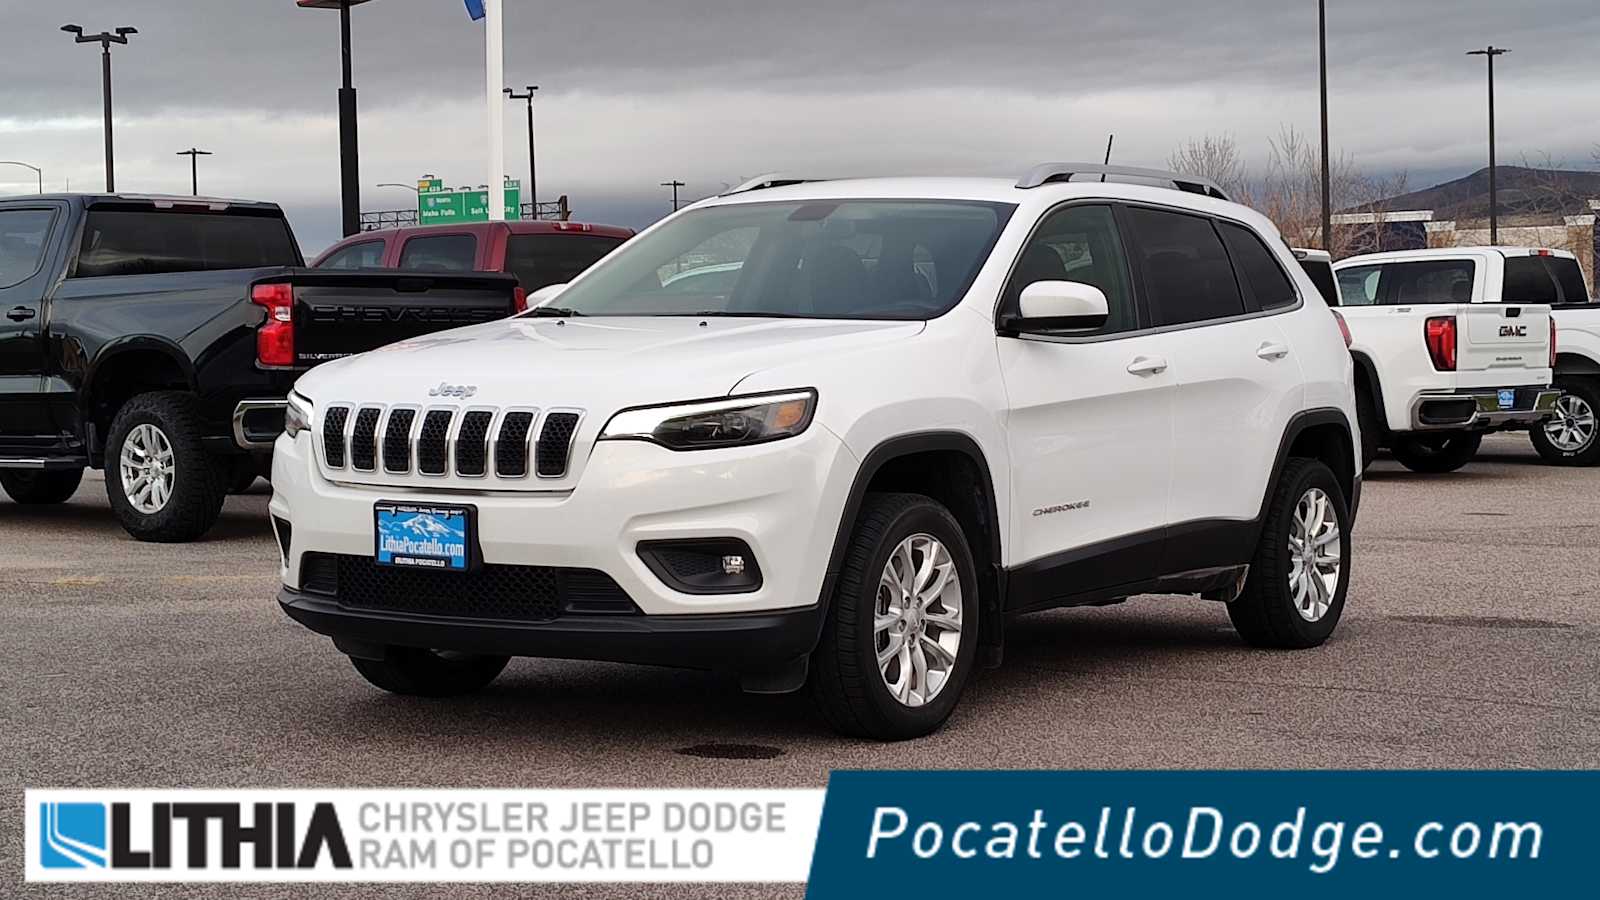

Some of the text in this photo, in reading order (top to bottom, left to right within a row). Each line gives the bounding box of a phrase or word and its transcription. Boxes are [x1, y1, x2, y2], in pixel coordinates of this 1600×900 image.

[1499, 326, 1527, 337] GMC
[429, 382, 477, 400] Jeep
[1032, 500, 1090, 516] CHEROKEE
[380, 534, 464, 556] LithiaPocatello.com
